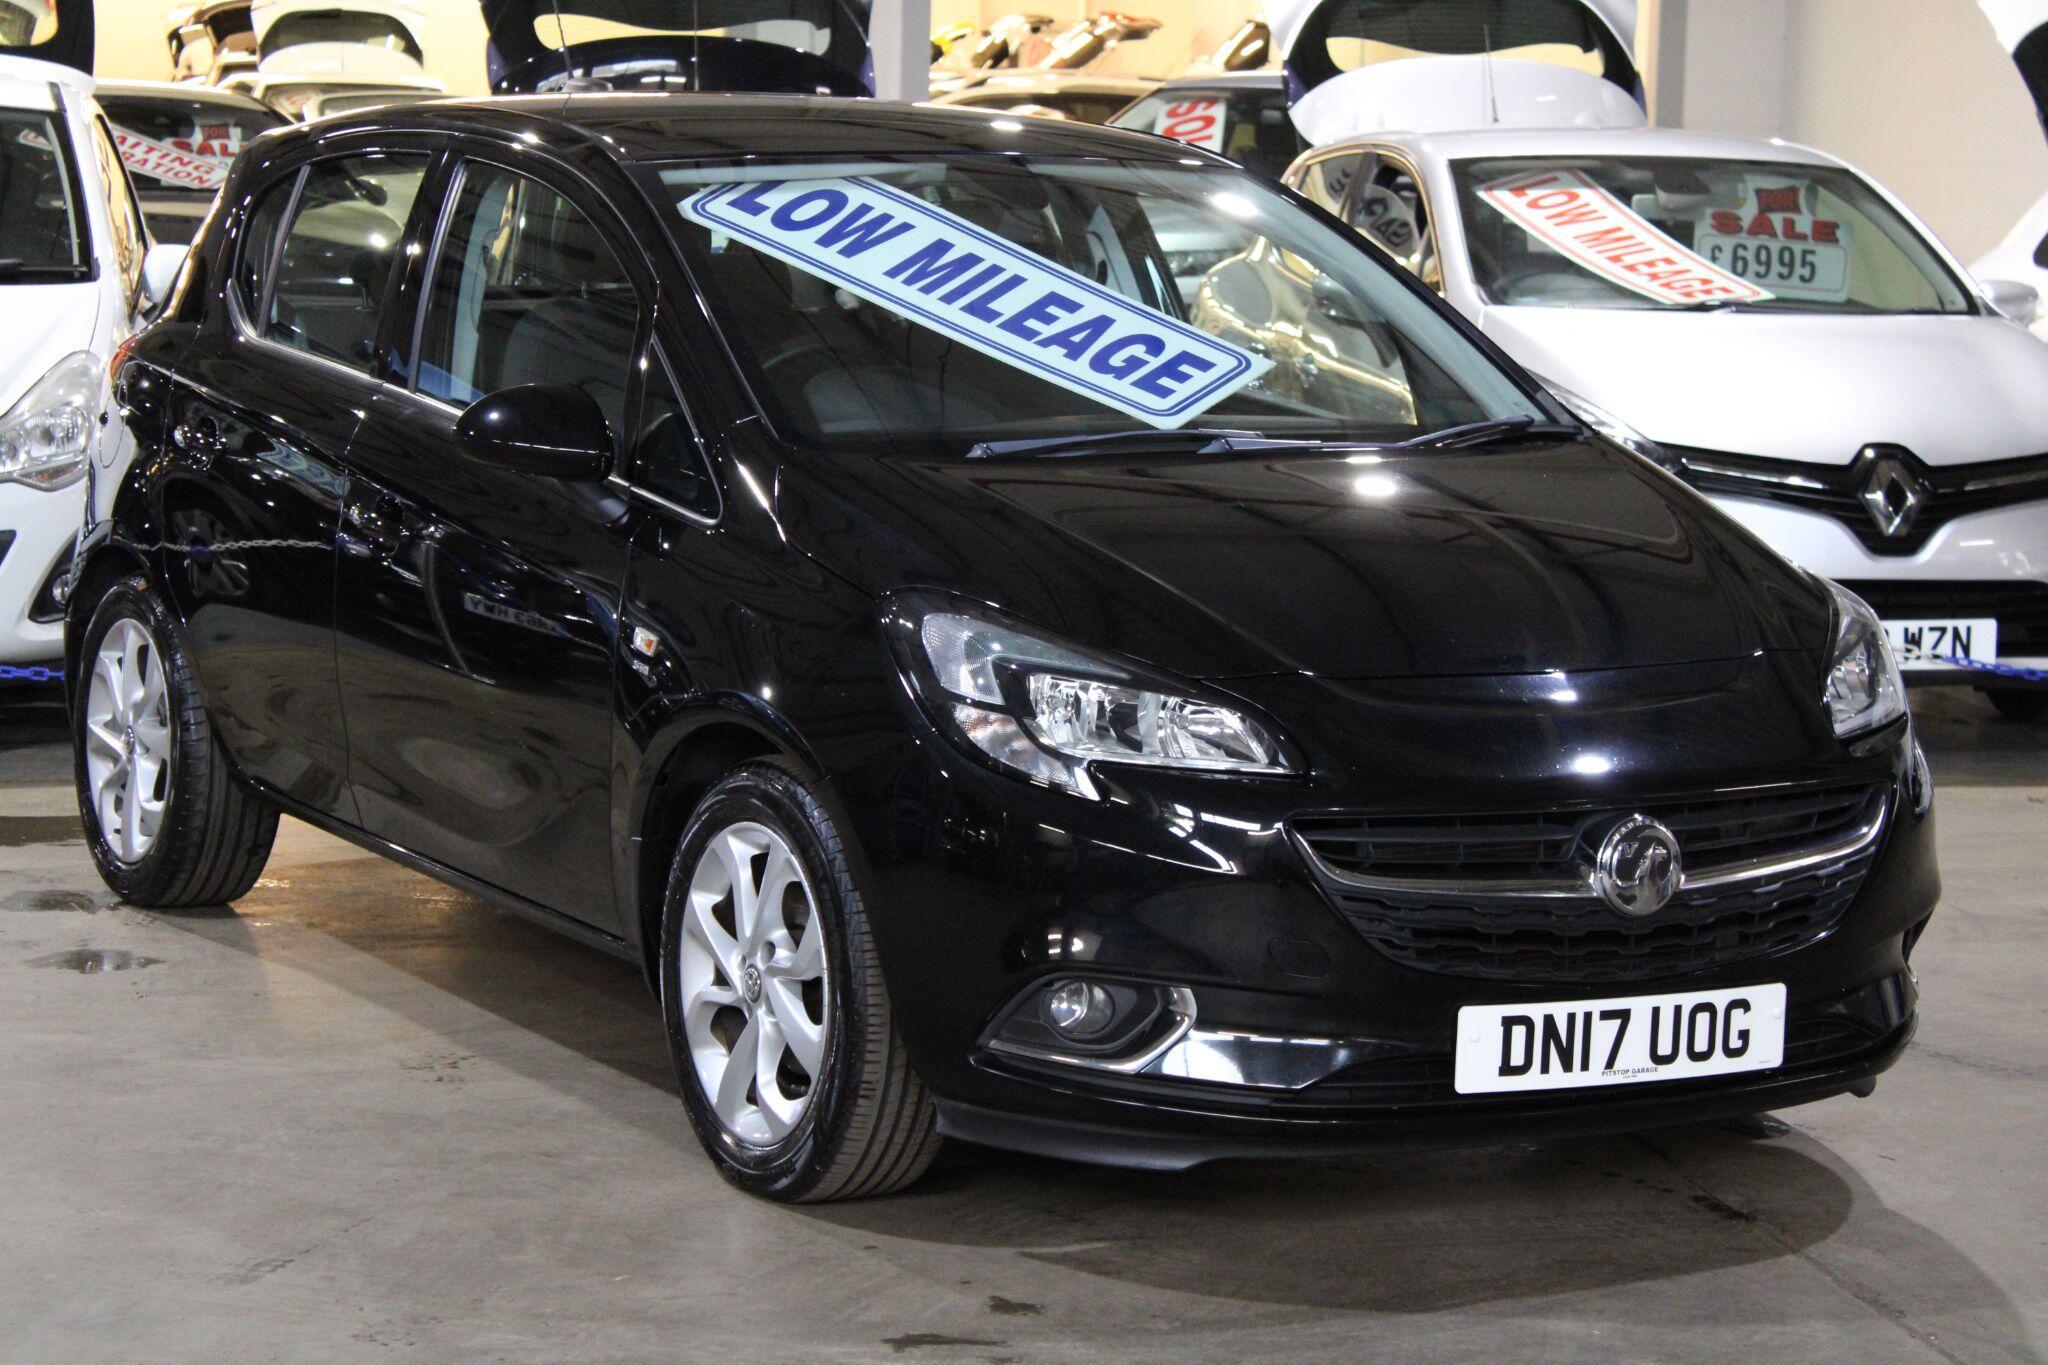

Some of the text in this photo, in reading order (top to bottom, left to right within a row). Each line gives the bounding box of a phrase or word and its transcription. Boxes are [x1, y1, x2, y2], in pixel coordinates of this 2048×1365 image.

[1509, 177, 1735, 299] LOW MILEAGE
[1710, 210, 1841, 244] SALE
[726, 181, 1217, 400] LOW MILEAGE
[1498, 998, 1752, 1077] DN17 UOG
[1601, 1068, 1630, 1077] PITSTOP
[1631, 1066, 1659, 1075] GARAGE
